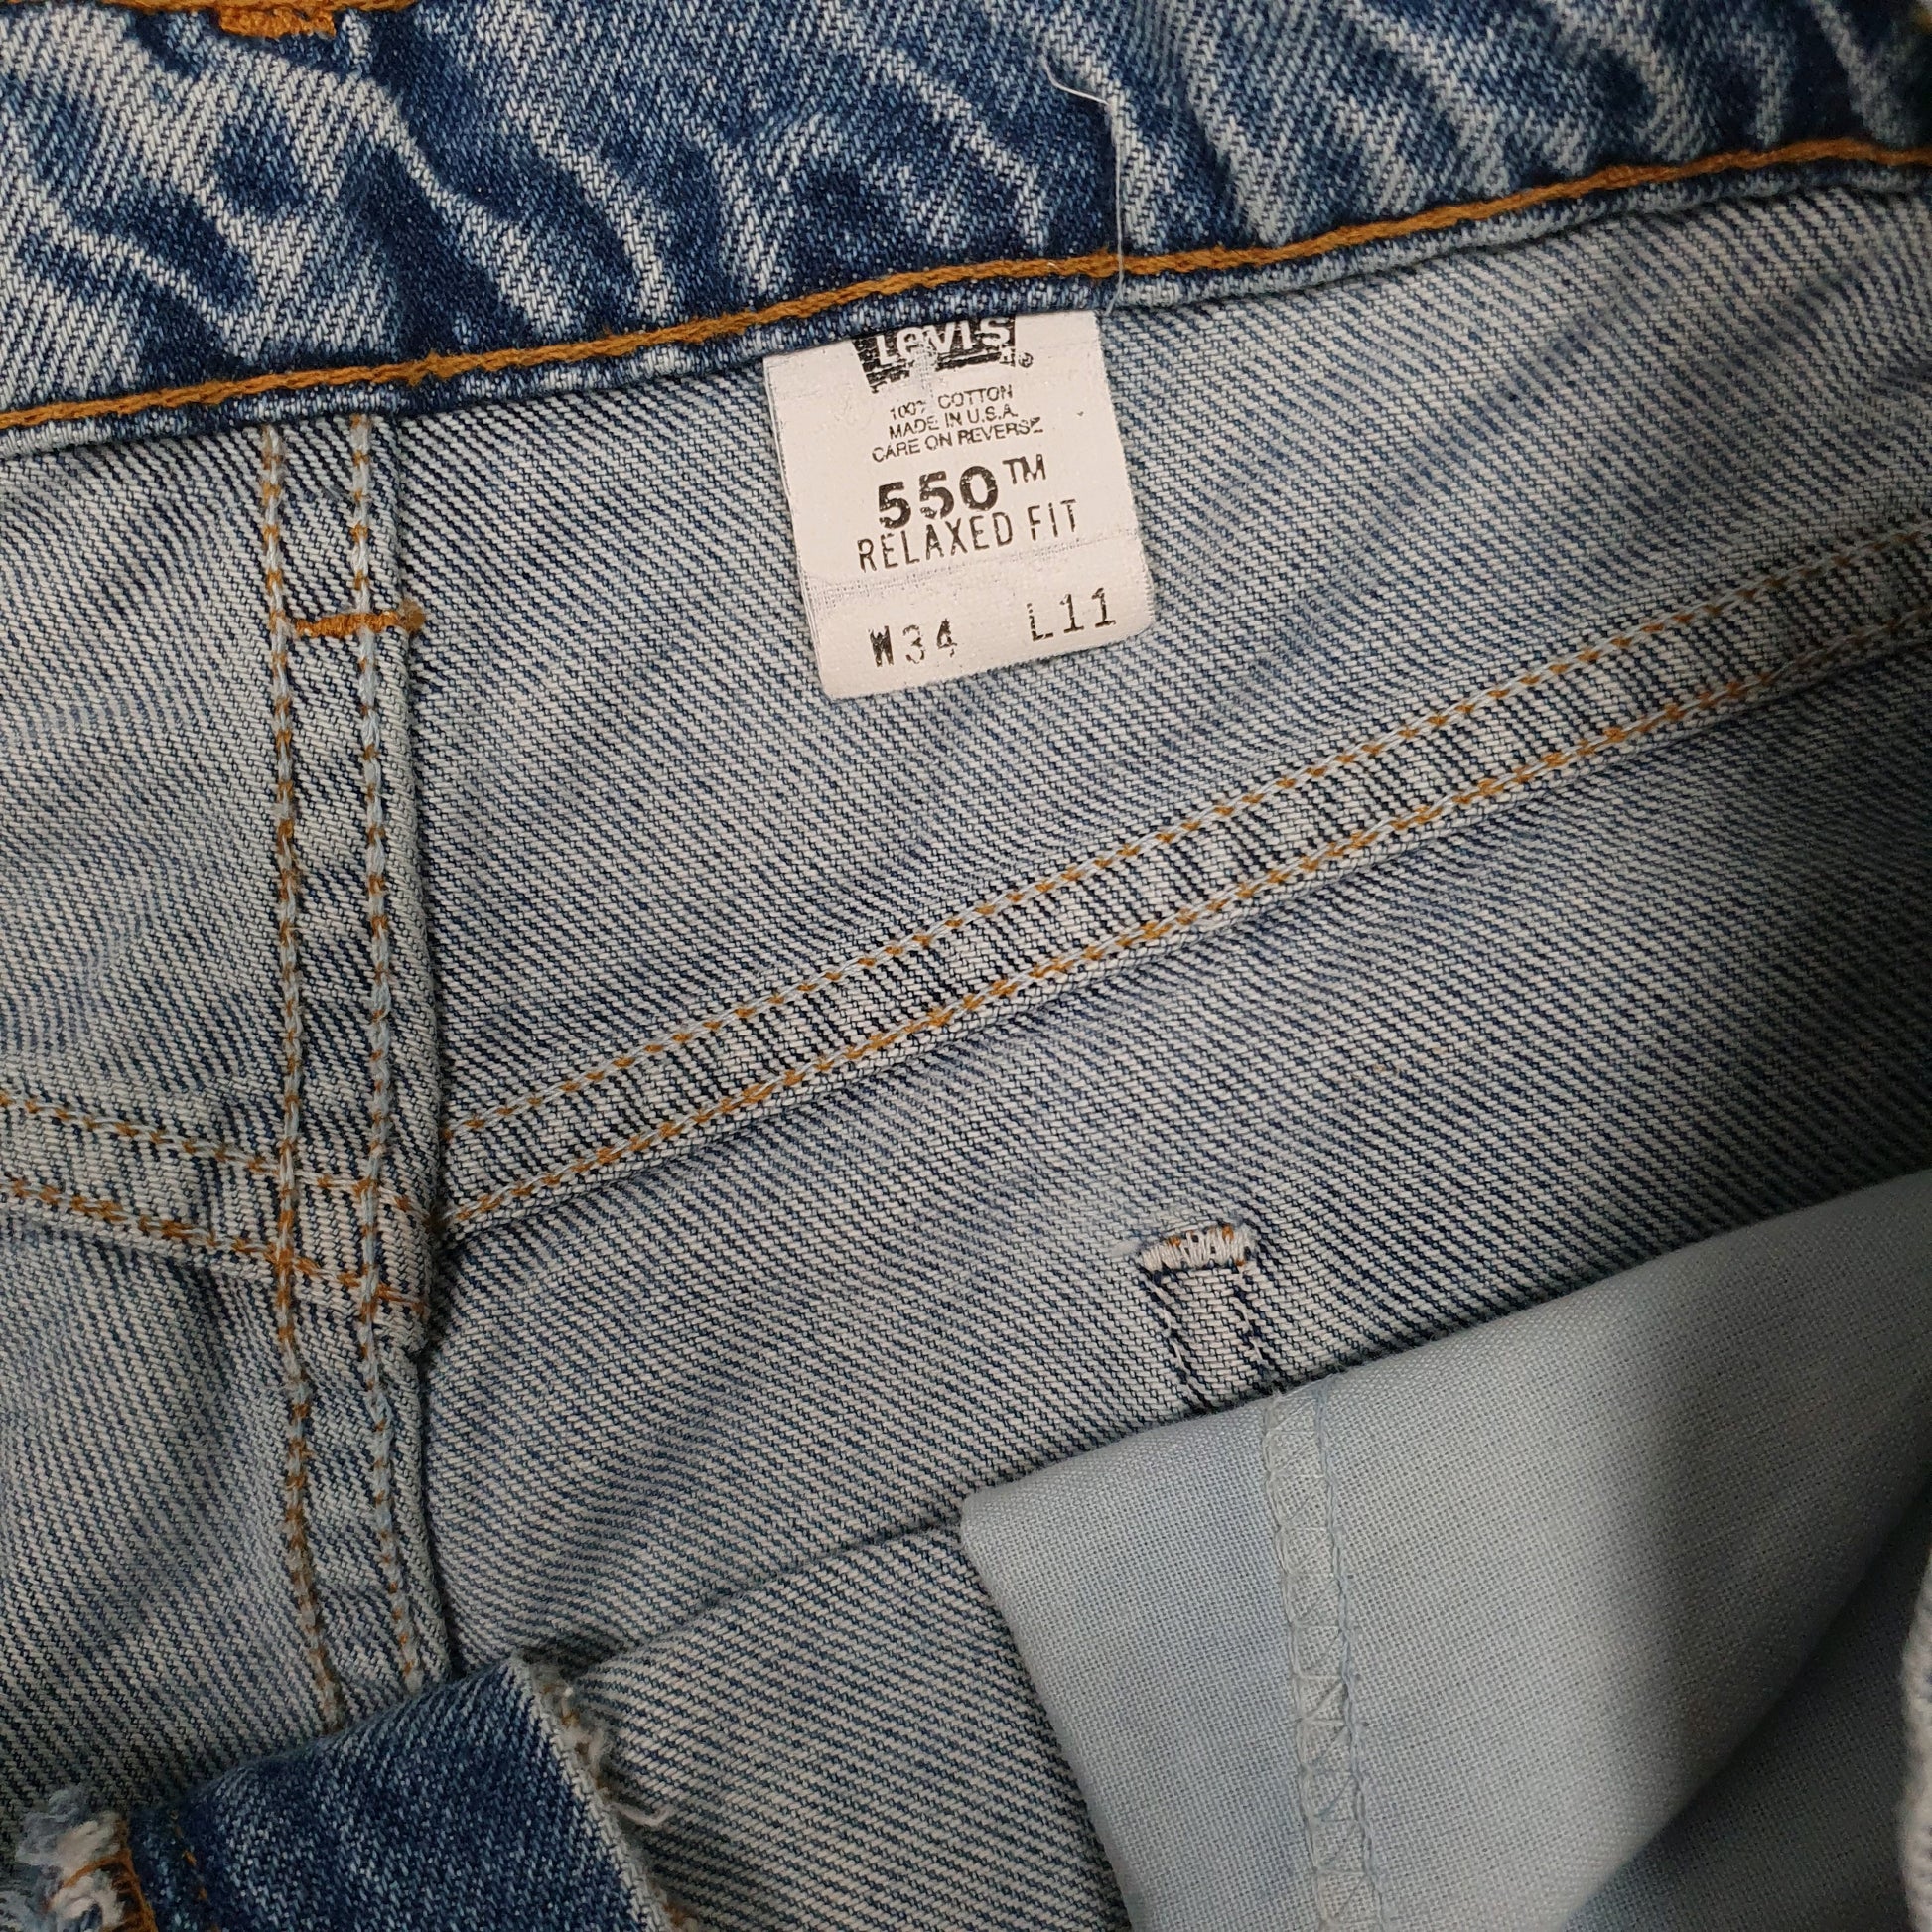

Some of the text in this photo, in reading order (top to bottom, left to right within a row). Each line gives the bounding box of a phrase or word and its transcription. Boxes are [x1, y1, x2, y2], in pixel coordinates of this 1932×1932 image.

[937, 384, 1013, 409] COTTON
[889, 415, 939, 440] MADE
[944, 410, 963, 428] IN
[872, 443, 921, 463] CARE
[924, 432, 952, 451] ON
[857, 499, 1076, 573] RELAXED FIT
[868, 587, 1116, 668] W34 L11
